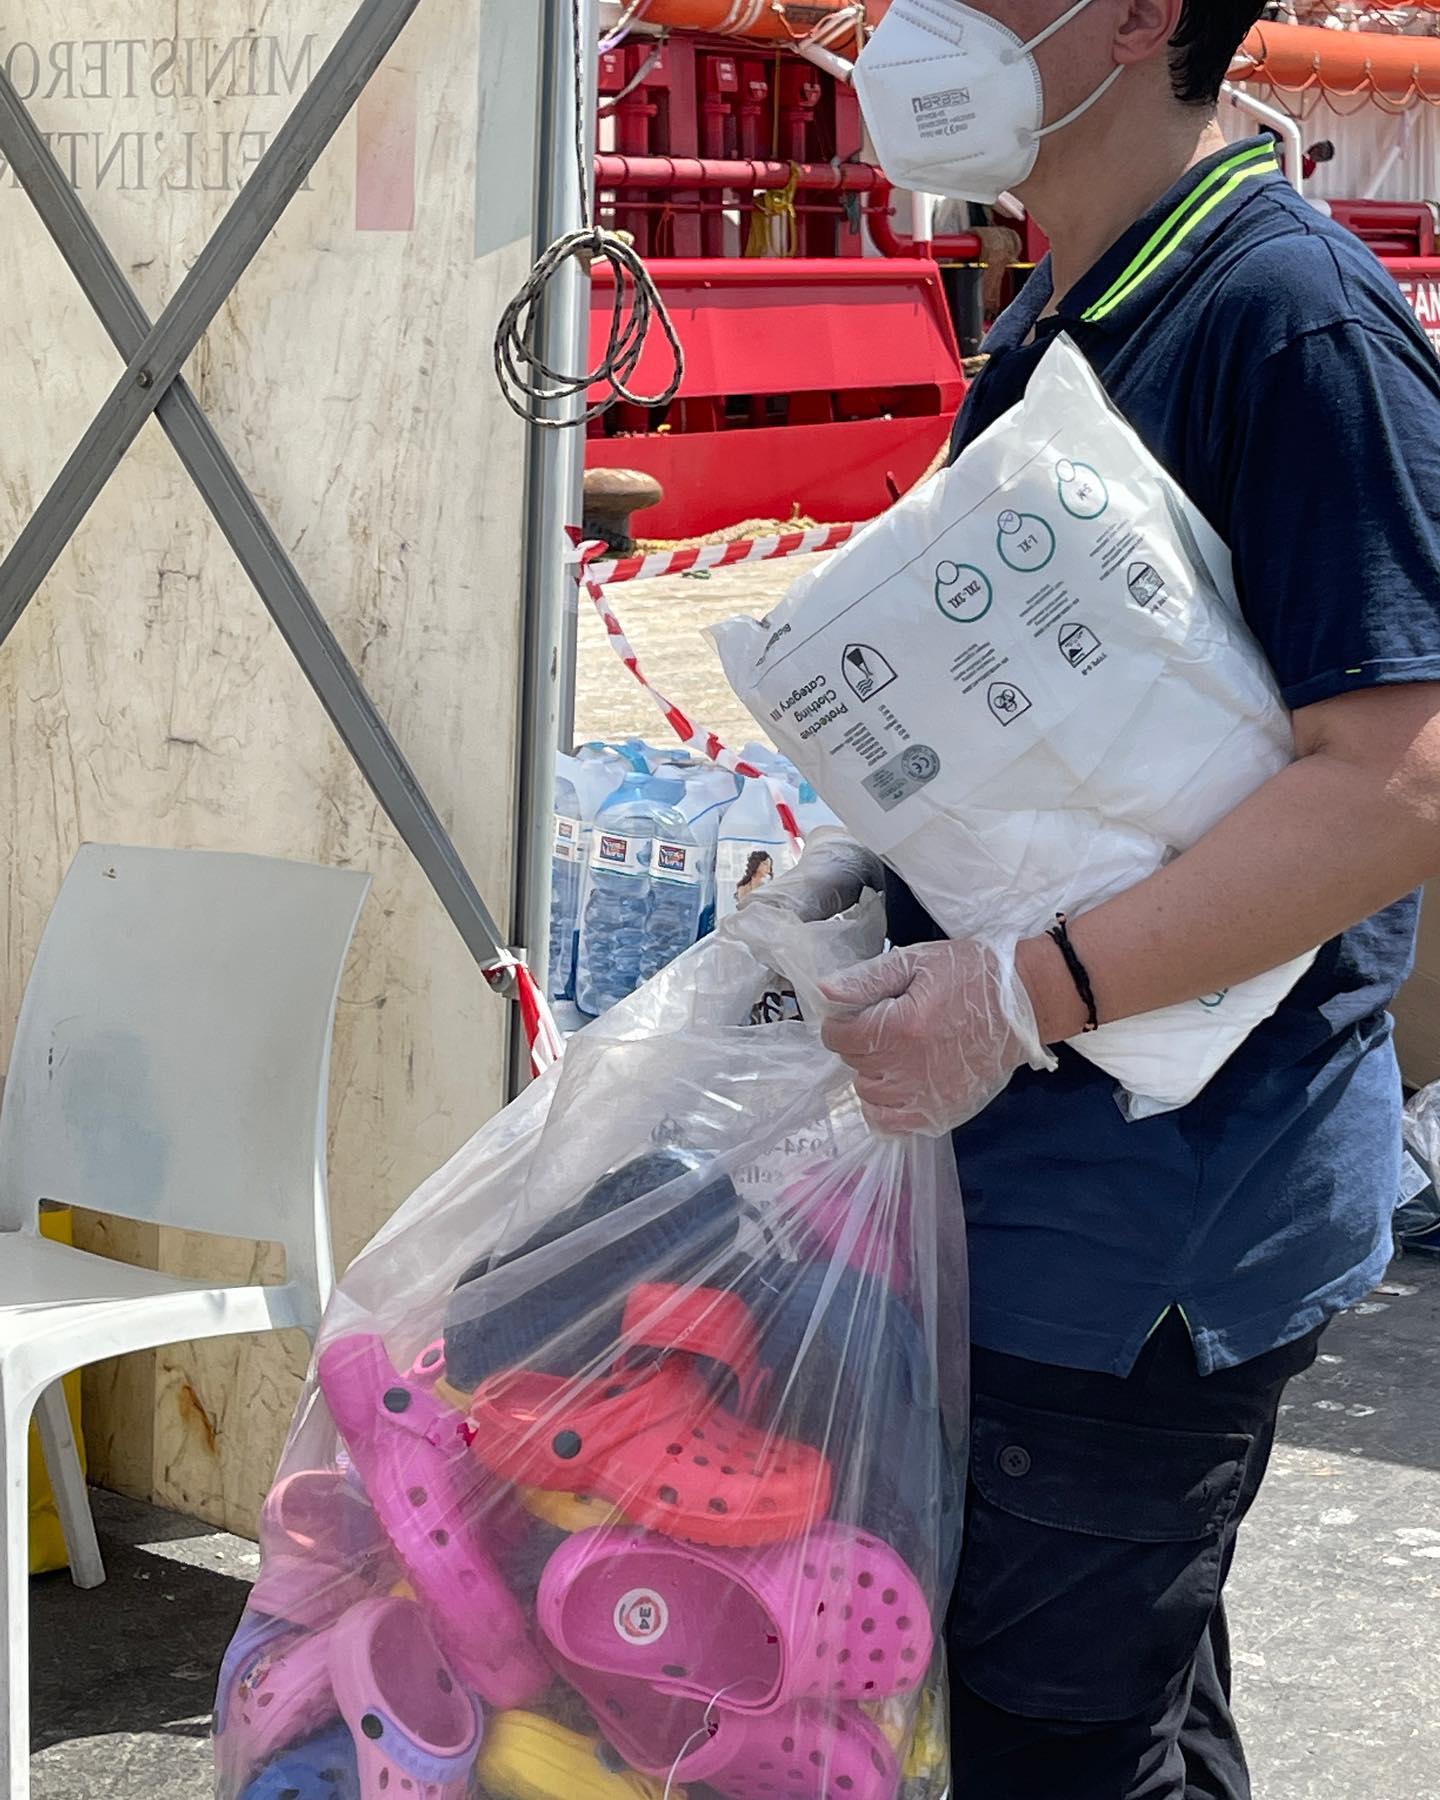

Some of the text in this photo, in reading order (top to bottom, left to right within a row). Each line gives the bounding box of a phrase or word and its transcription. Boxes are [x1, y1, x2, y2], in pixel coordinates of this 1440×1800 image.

[1018, 534, 1038, 554] L-XL
[948, 580, 981, 609] 2XL-3XL
[769, 674, 826, 722] Category III
[794, 689, 837, 723] Clothing
[800, 702, 848, 740] Protective
[639, 1606, 652, 1630] 34
